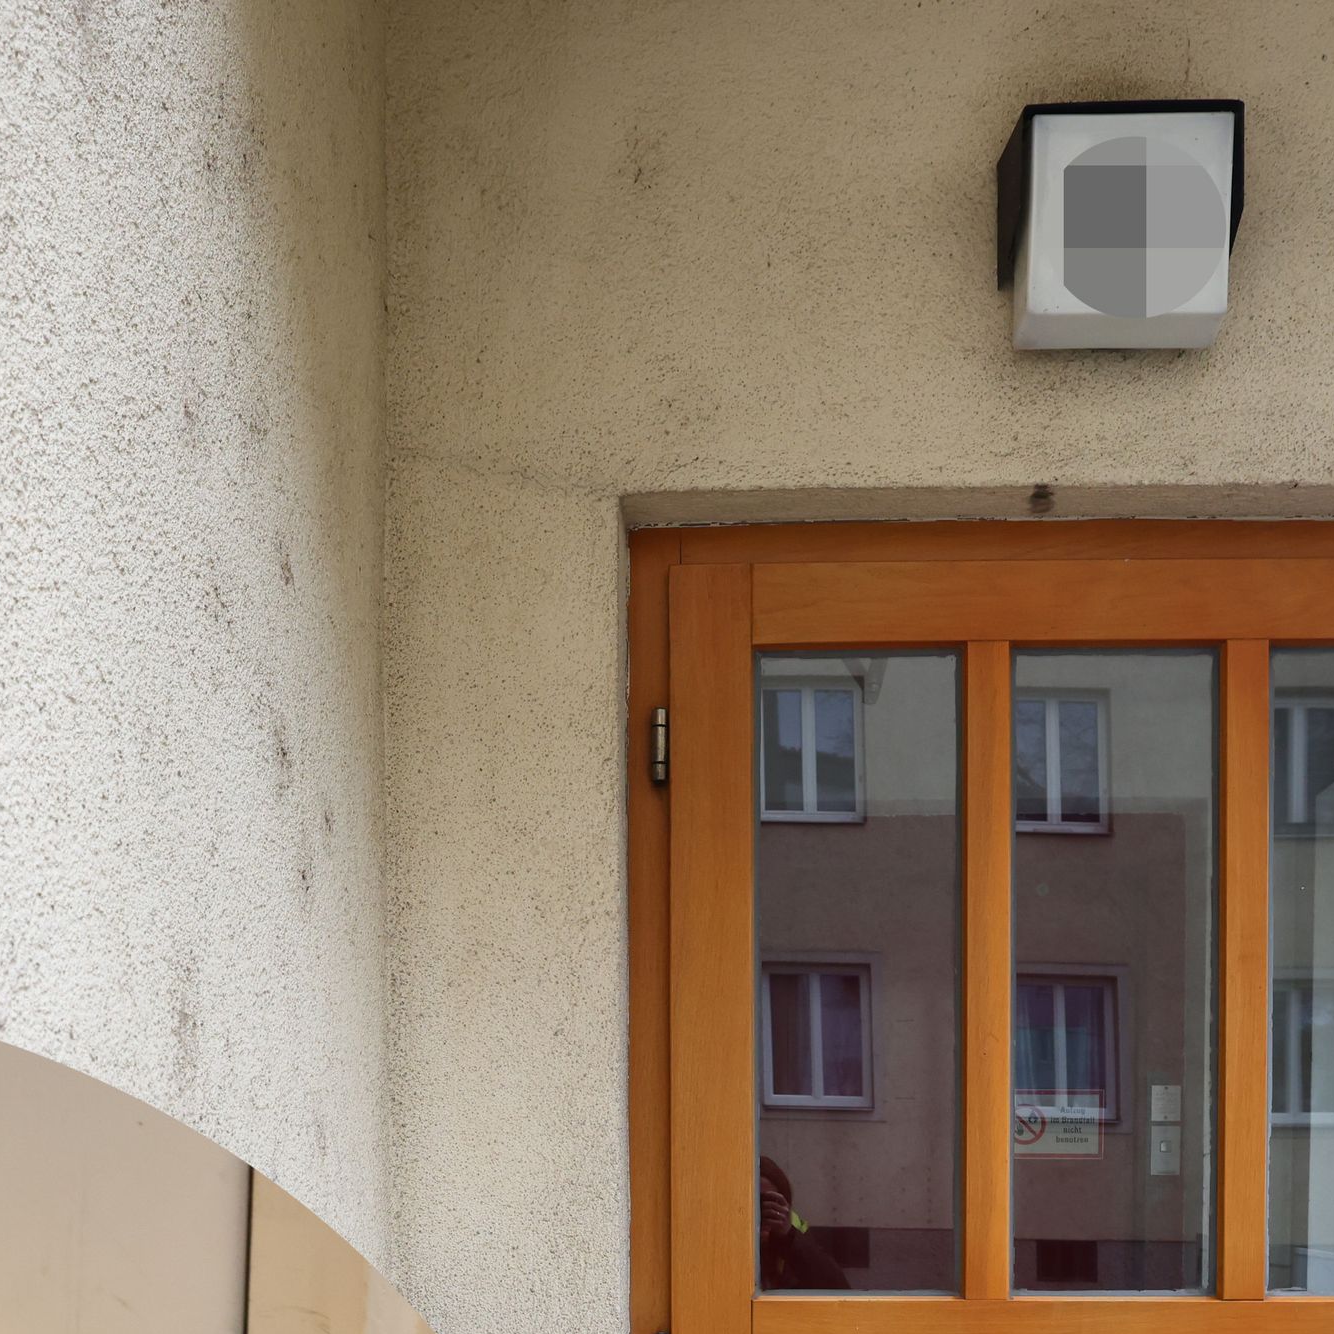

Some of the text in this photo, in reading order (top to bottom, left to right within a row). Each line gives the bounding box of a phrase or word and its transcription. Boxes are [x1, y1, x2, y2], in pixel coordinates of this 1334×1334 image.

[1060, 1106, 1086, 1115] Aufzug
[1050, 1116, 1095, 1124] im Brandfall
[1063, 1126, 1082, 1134] nicht
